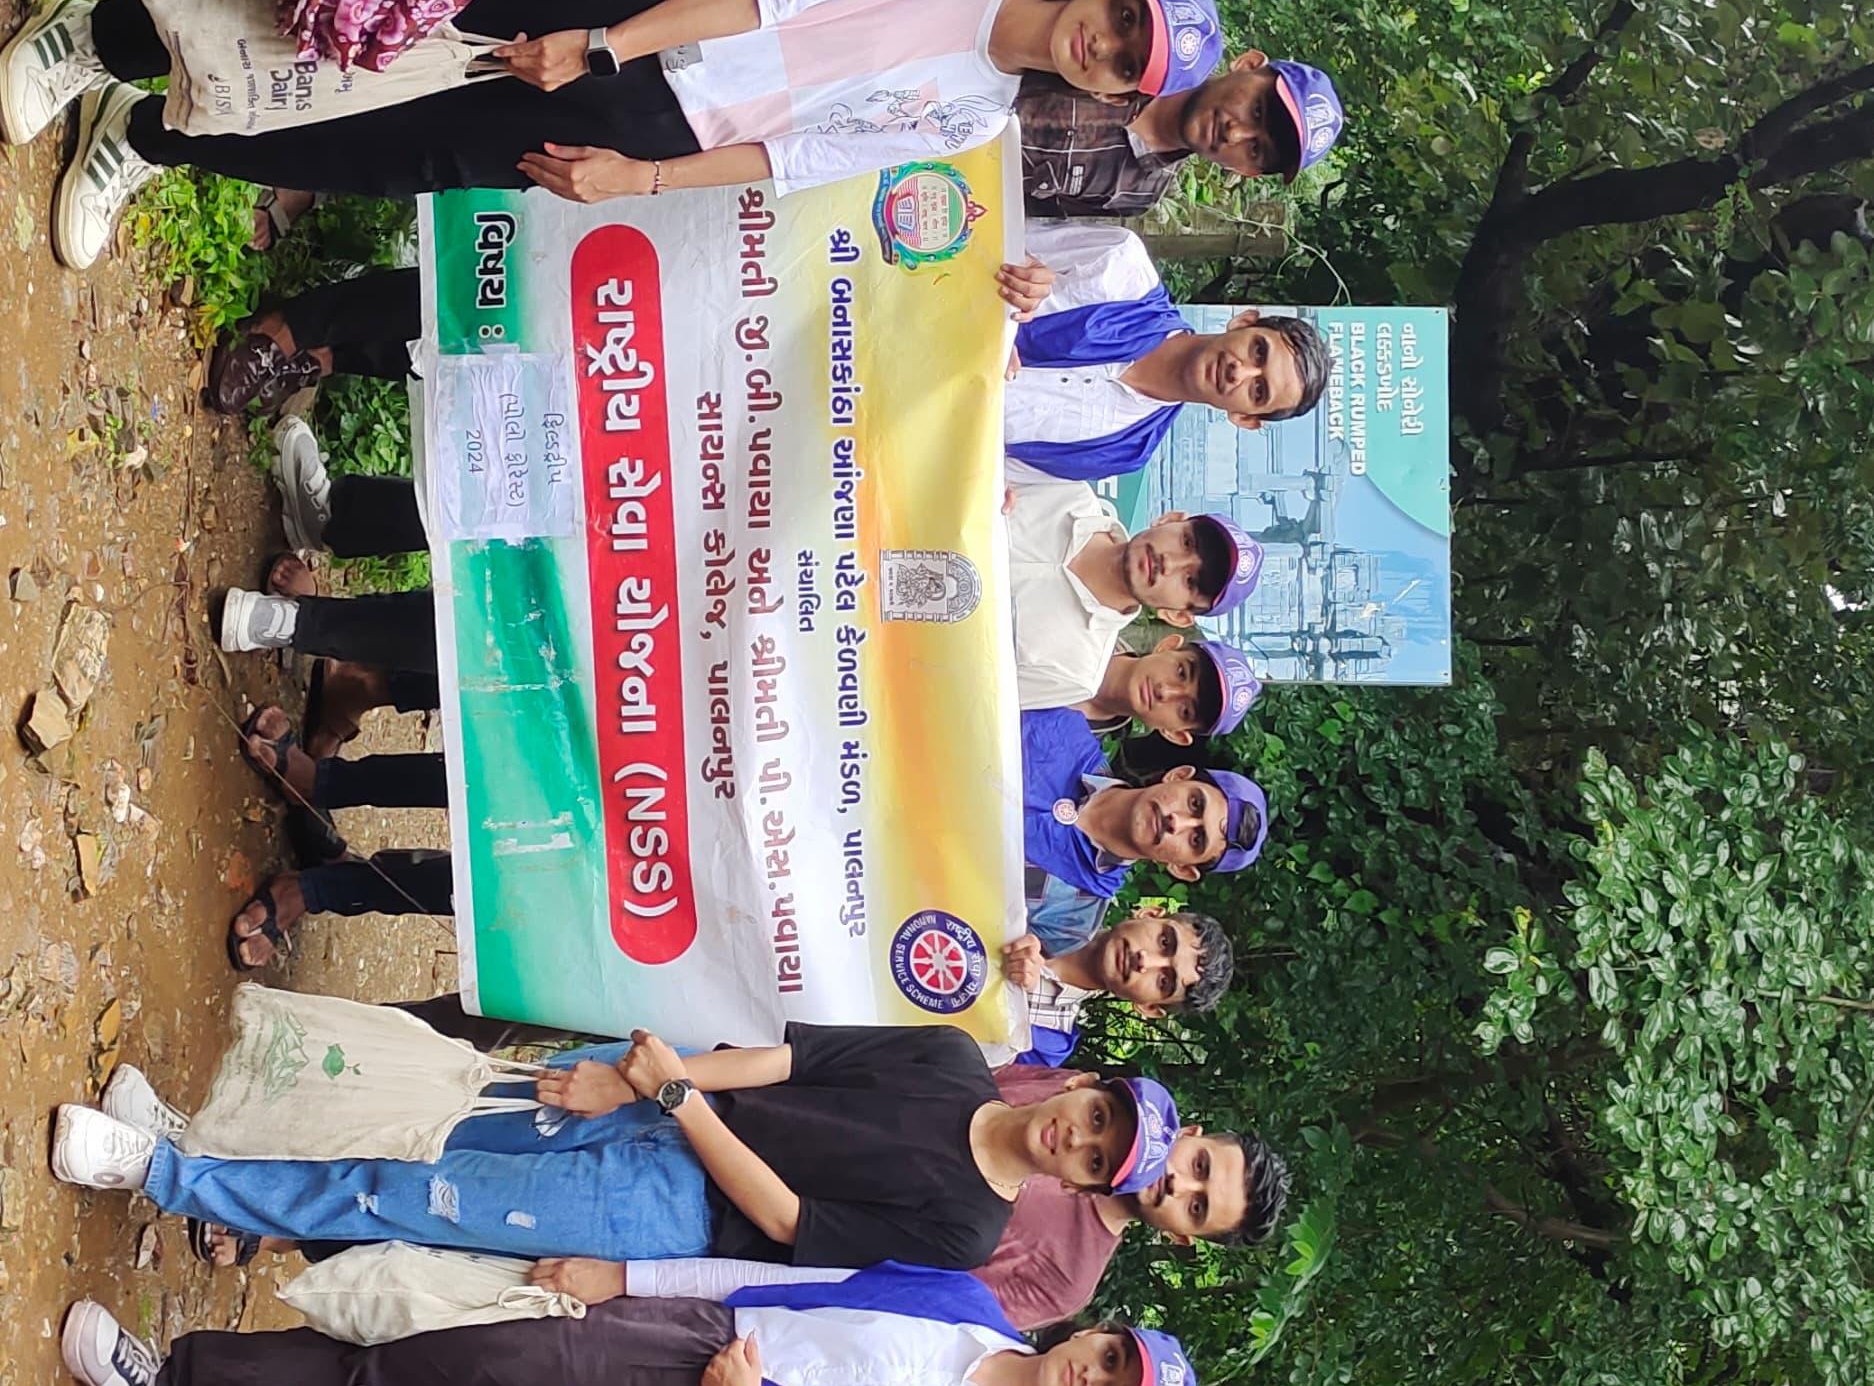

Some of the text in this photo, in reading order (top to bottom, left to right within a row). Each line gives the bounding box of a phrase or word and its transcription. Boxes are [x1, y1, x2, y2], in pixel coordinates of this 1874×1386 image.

[475, 213, 516, 307] વિષય
[739, 187, 778, 297] શ્રીમતી
[1328, 322, 1345, 441] FLAMEBACK
[1350, 322, 1366, 476] BLACK RUMPED
[1400, 323, 1424, 436] નાનો સોનેરી
[466, 429, 484, 473] 2024
[587, 278, 678, 917] રાષ્ટ્રીય સેવા યોજના (NSS)
[697, 391, 736, 799] સાયન્સ કોલેજ, પાલનપુર
[748, 548, 784, 615] અને
[798, 550, 821, 632] સંચાલિત
[830, 228, 868, 938] શ્રી બનાસકાંઠા આંજણા પટેલ કેળવણી મંડળ, પાલનપુર
[751, 634, 789, 743] શ્રીમતી
[895, 915, 944, 1009] NATIONAL SERVICE SCHEME
[945, 919, 984, 1008] राष्ट्रीय सेवा योजना
